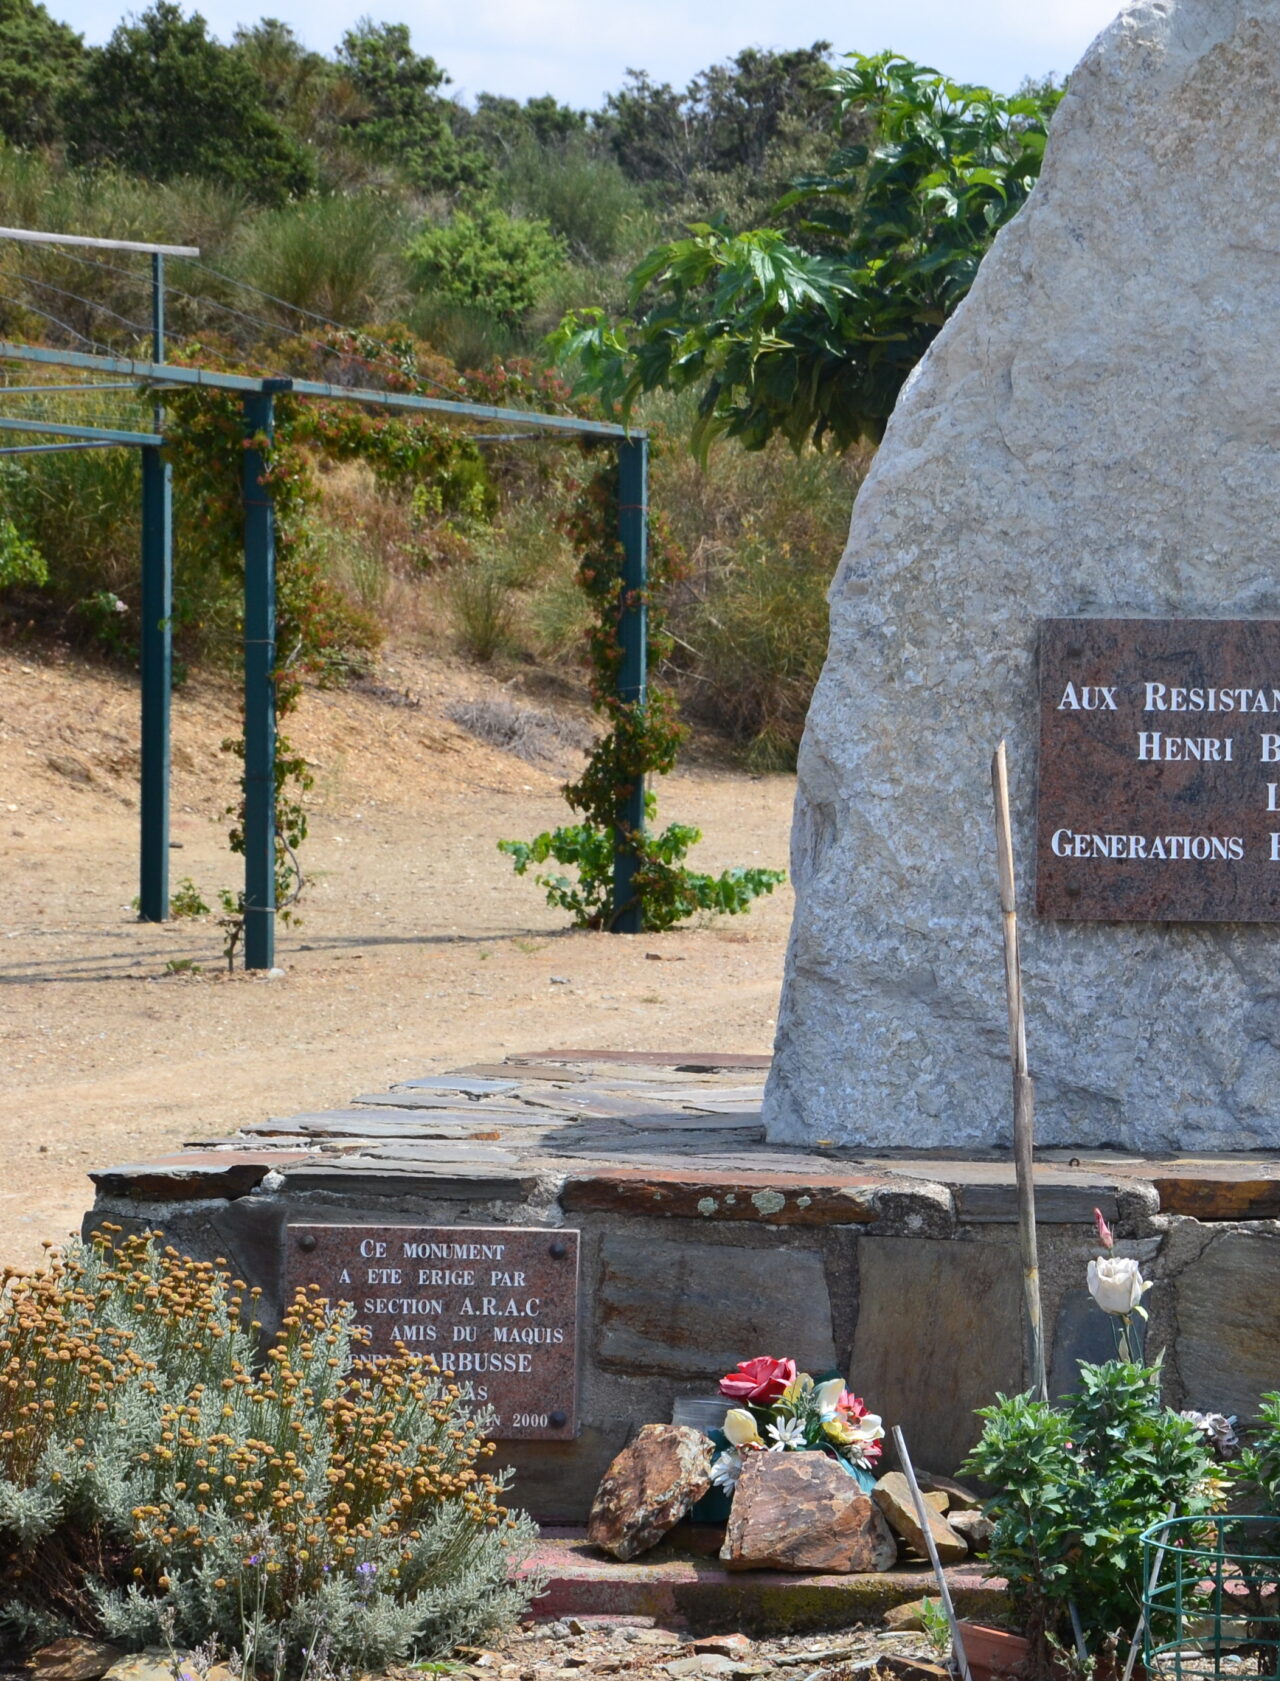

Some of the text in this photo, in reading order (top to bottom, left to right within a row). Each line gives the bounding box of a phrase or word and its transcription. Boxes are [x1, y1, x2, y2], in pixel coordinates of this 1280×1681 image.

[1057, 681, 1118, 710] AUX
[1137, 731, 1233, 762] HENRI
[1051, 828, 1244, 860] GENERATIONS
[360, 1238, 505, 1260] CE MONUMENT
[338, 1268, 526, 1287] A ETE ERIGE PAR
[364, 1298, 443, 1315] SECTION
[389, 1325, 437, 1343] AMIS
[453, 1326, 477, 1342] DU
[493, 1326, 564, 1345] MAQUIS
[512, 1413, 548, 1428] 2000
